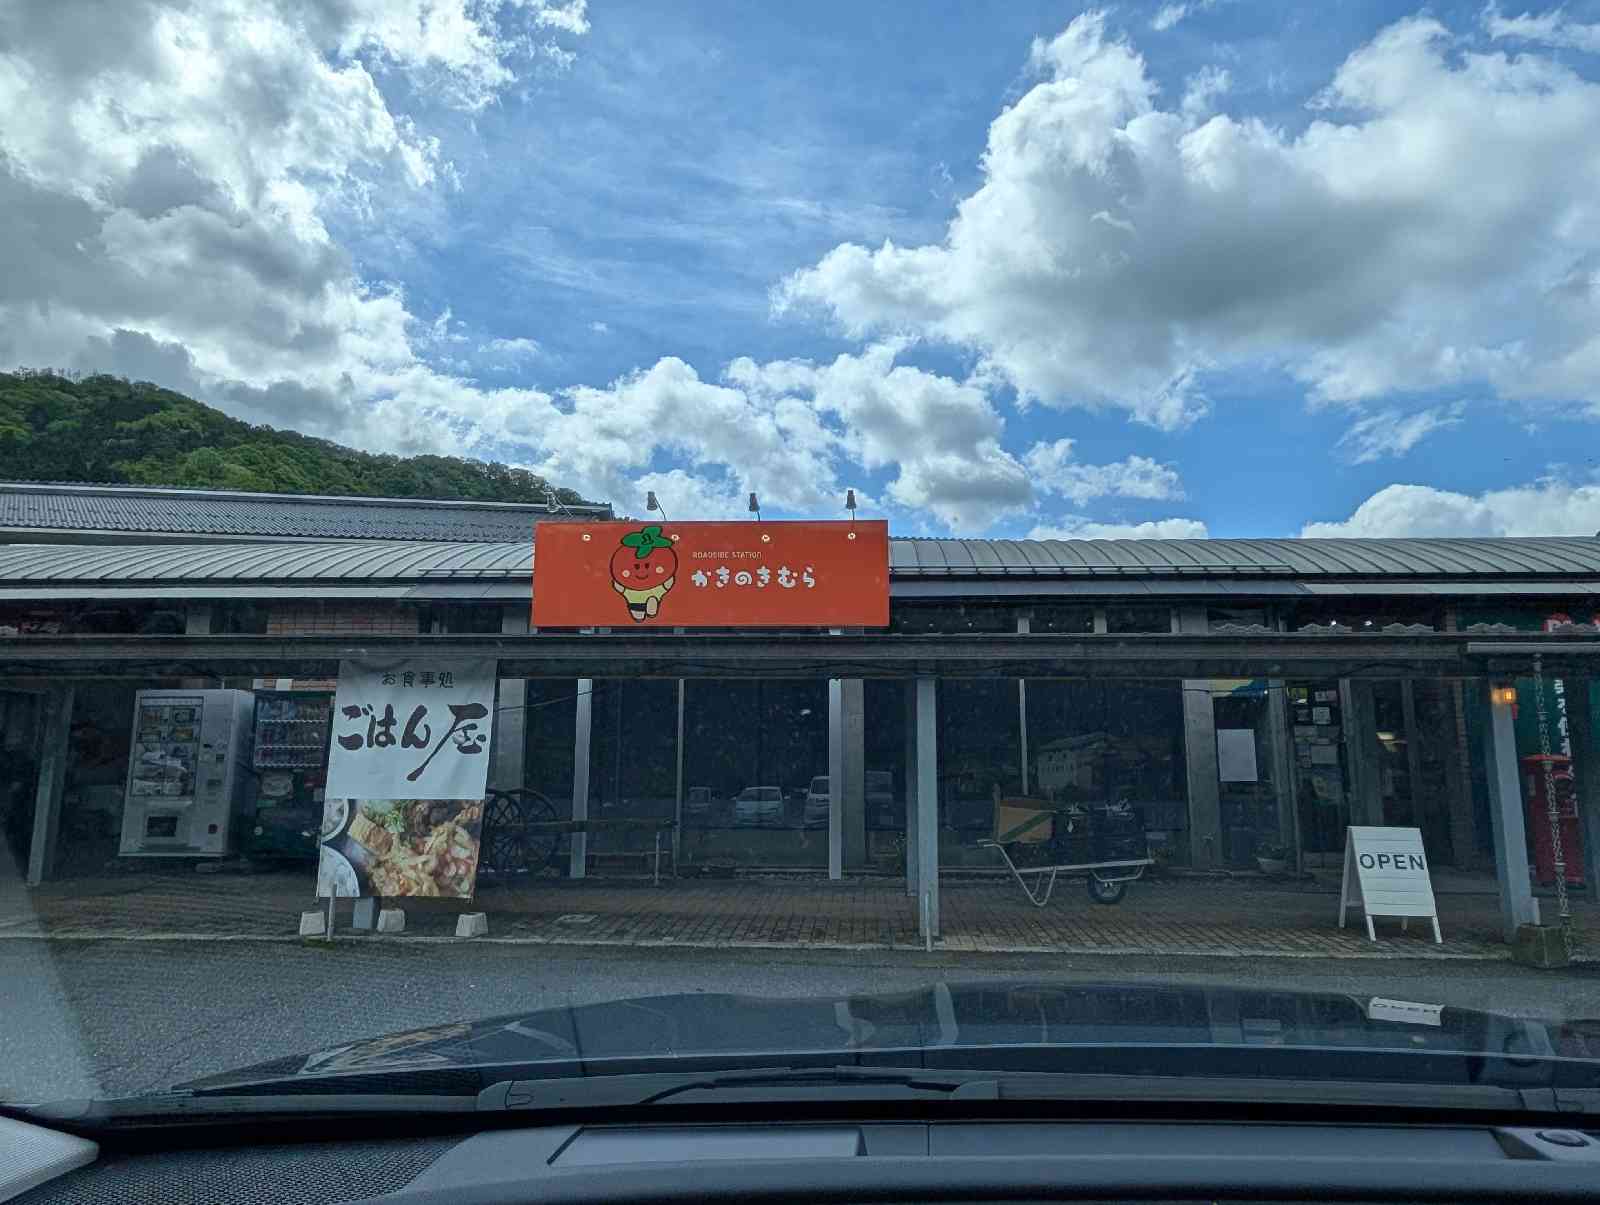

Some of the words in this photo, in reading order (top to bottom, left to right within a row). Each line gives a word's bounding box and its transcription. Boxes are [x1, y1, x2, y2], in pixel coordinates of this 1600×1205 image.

[692, 551, 729, 559] ROADSIDE
[732, 551, 762, 559] STATION
[691, 565, 816, 588] かきのきむら
[381, 671, 454, 688] お食事処
[337, 702, 489, 781] ごはん屋
[1359, 853, 1425, 870] OPEN
